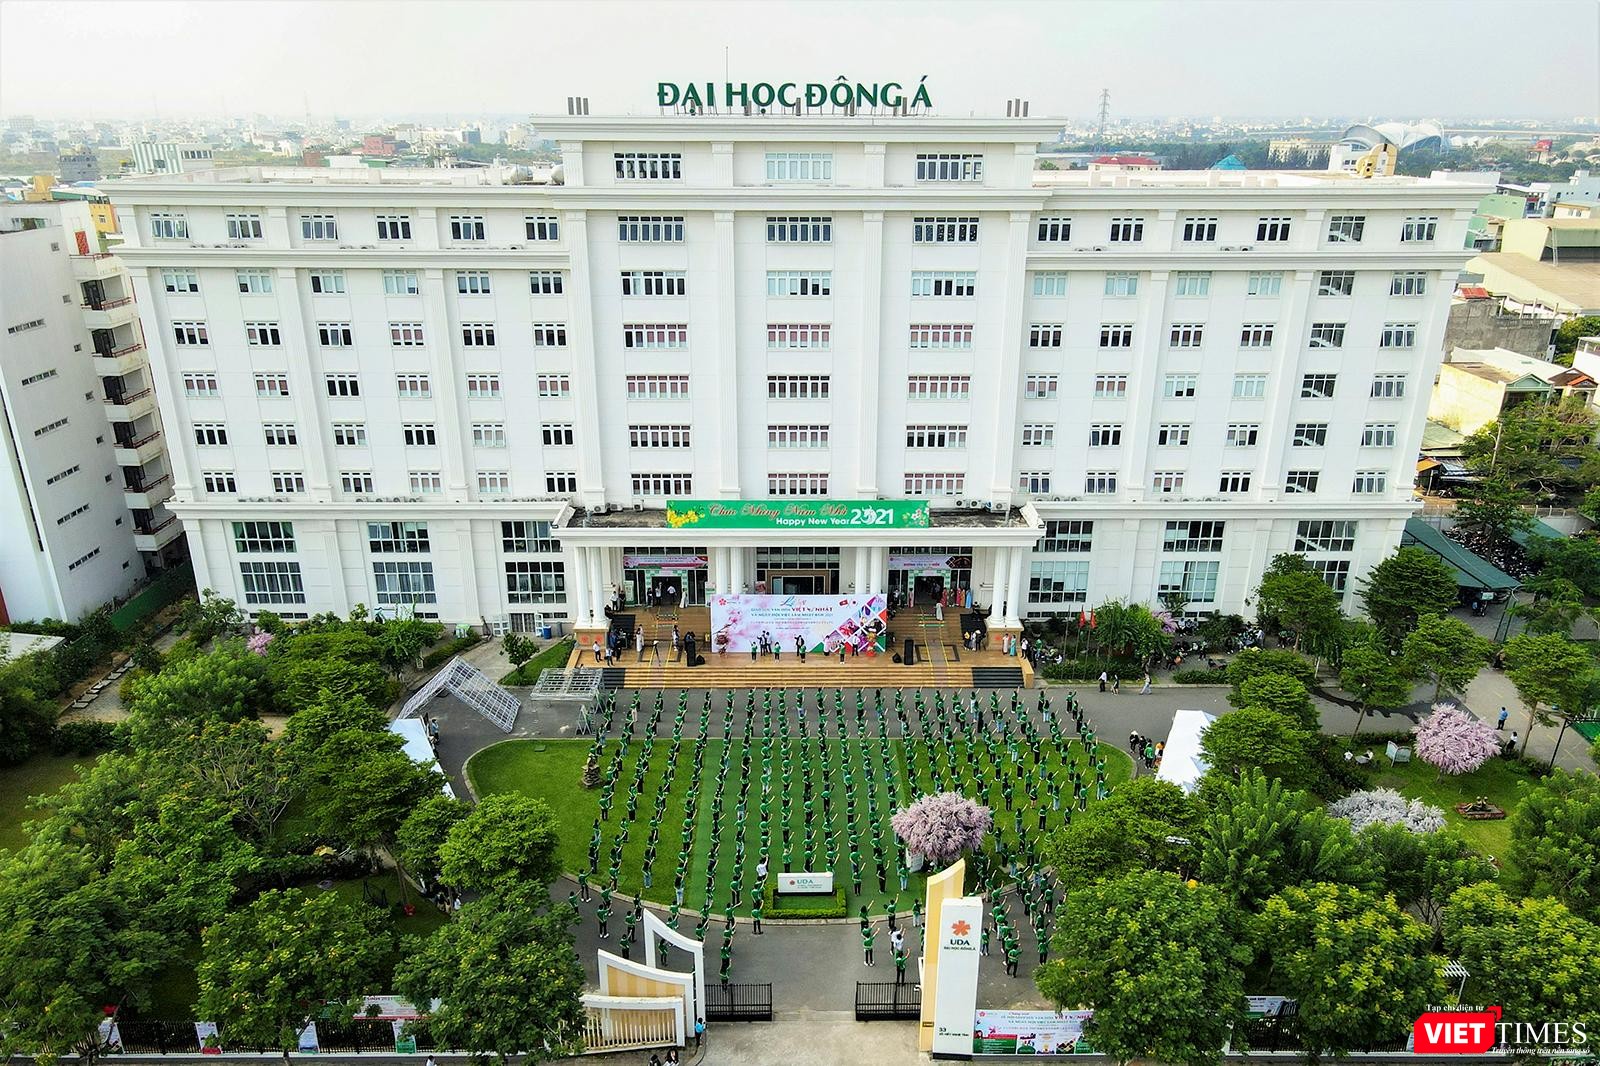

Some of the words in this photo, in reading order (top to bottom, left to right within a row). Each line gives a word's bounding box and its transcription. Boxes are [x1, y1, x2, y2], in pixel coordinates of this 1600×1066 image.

[657, 83, 715, 114] ĐẠI
[725, 83, 796, 114] HỌC
[805, 75, 903, 108] ĐÔNG
[911, 75, 932, 108] Á
[776, 517, 806, 527] Happy
[808, 517, 828, 525] New
[829, 517, 850, 525] Year
